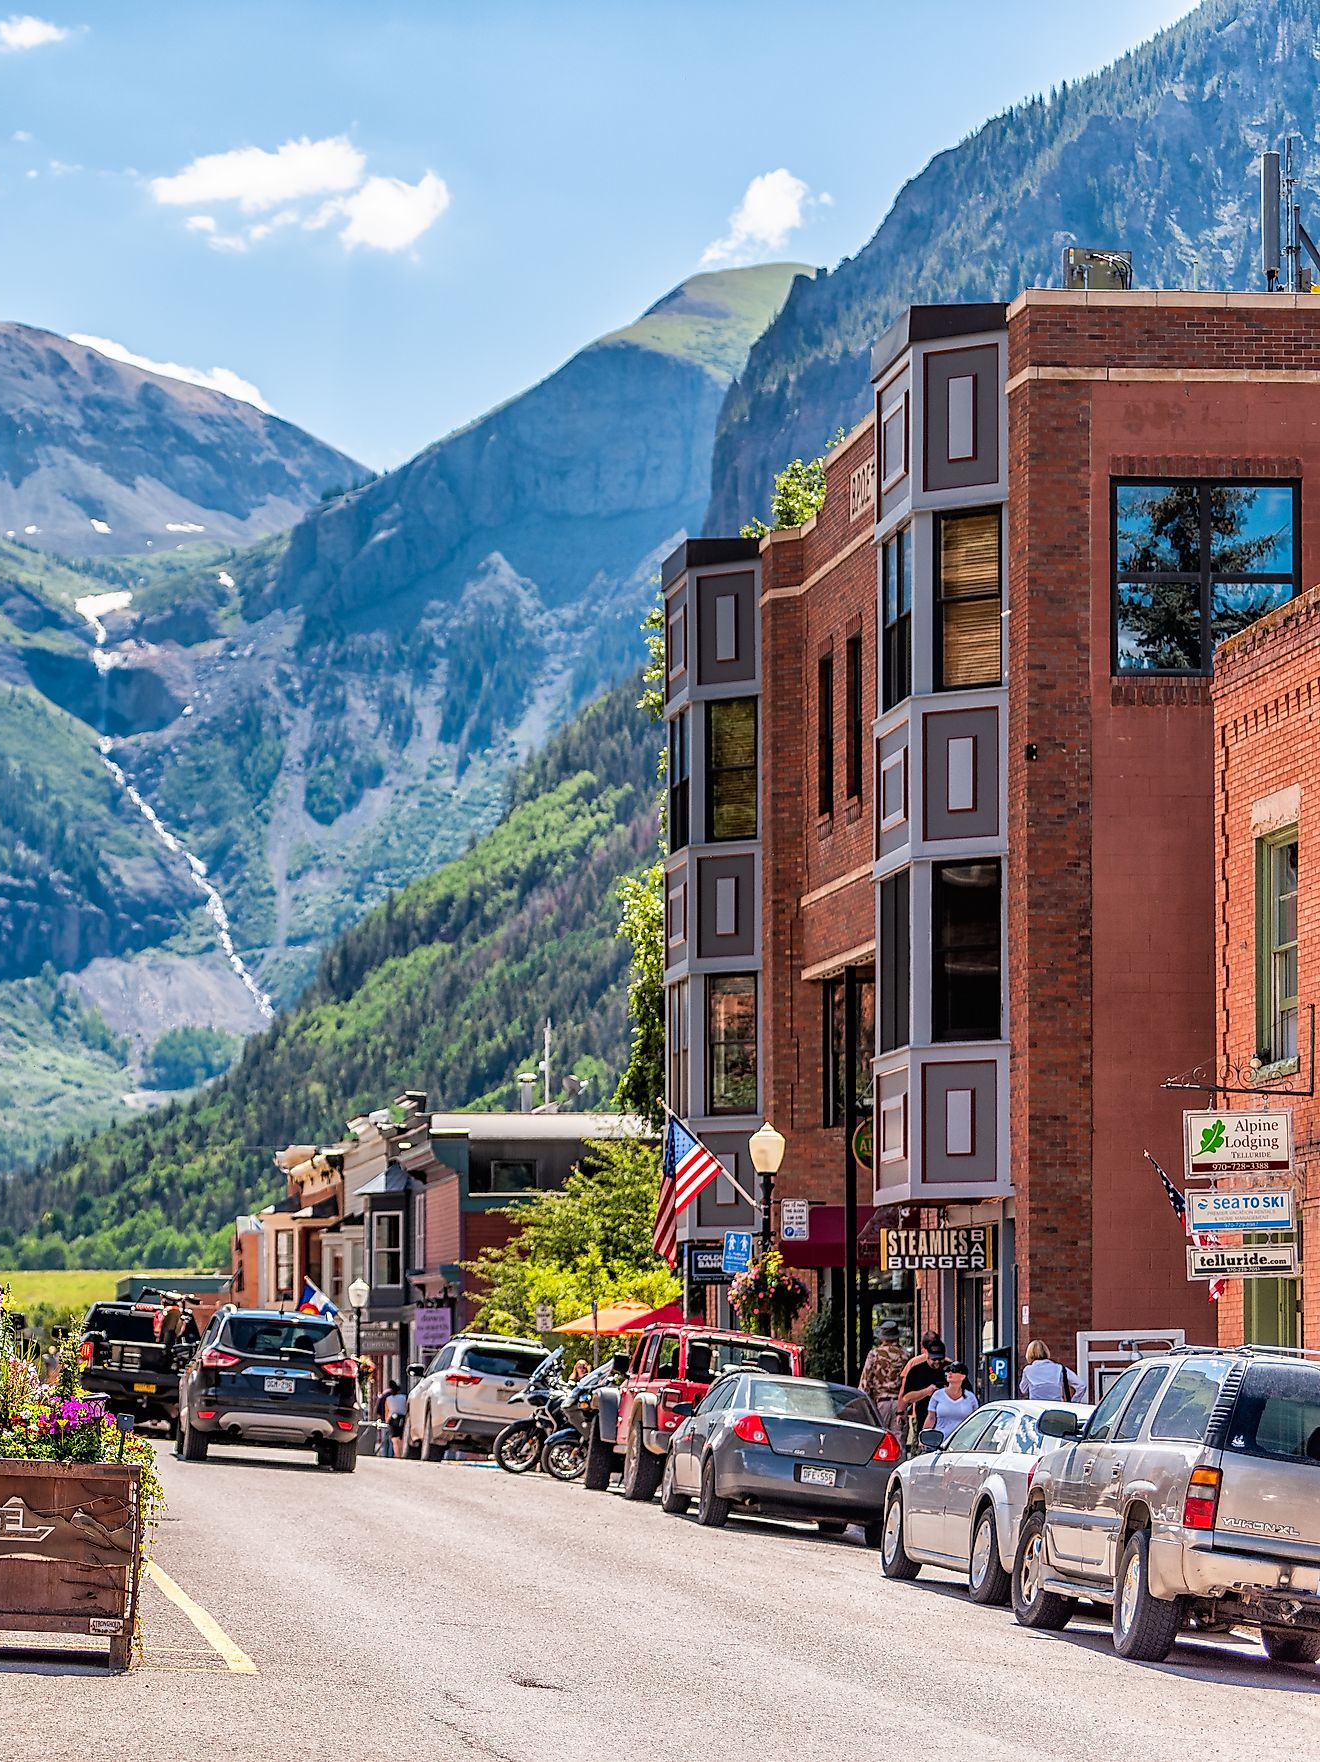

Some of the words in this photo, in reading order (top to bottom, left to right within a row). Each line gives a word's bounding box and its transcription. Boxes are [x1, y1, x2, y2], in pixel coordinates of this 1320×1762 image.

[1235, 1119, 1279, 1134] Alpine
[1225, 1135, 1280, 1150] Lodging
[1231, 1151, 1272, 1159] TELLURIDE
[1212, 1163, 1269, 1171] 970-728-3388
[1213, 1197, 1240, 1209] sea
[1242, 1197, 1260, 1208] TO
[1262, 1196, 1284, 1208] SKI
[888, 1230, 968, 1256] STEAMIES
[888, 1256, 985, 1270] BURGER
[1200, 1252, 1287, 1267] telluride.com
[995, 1359, 1005, 1376] P
[1221, 1517, 1277, 1532] YUKON
[1277, 1525, 1301, 1536] XL
